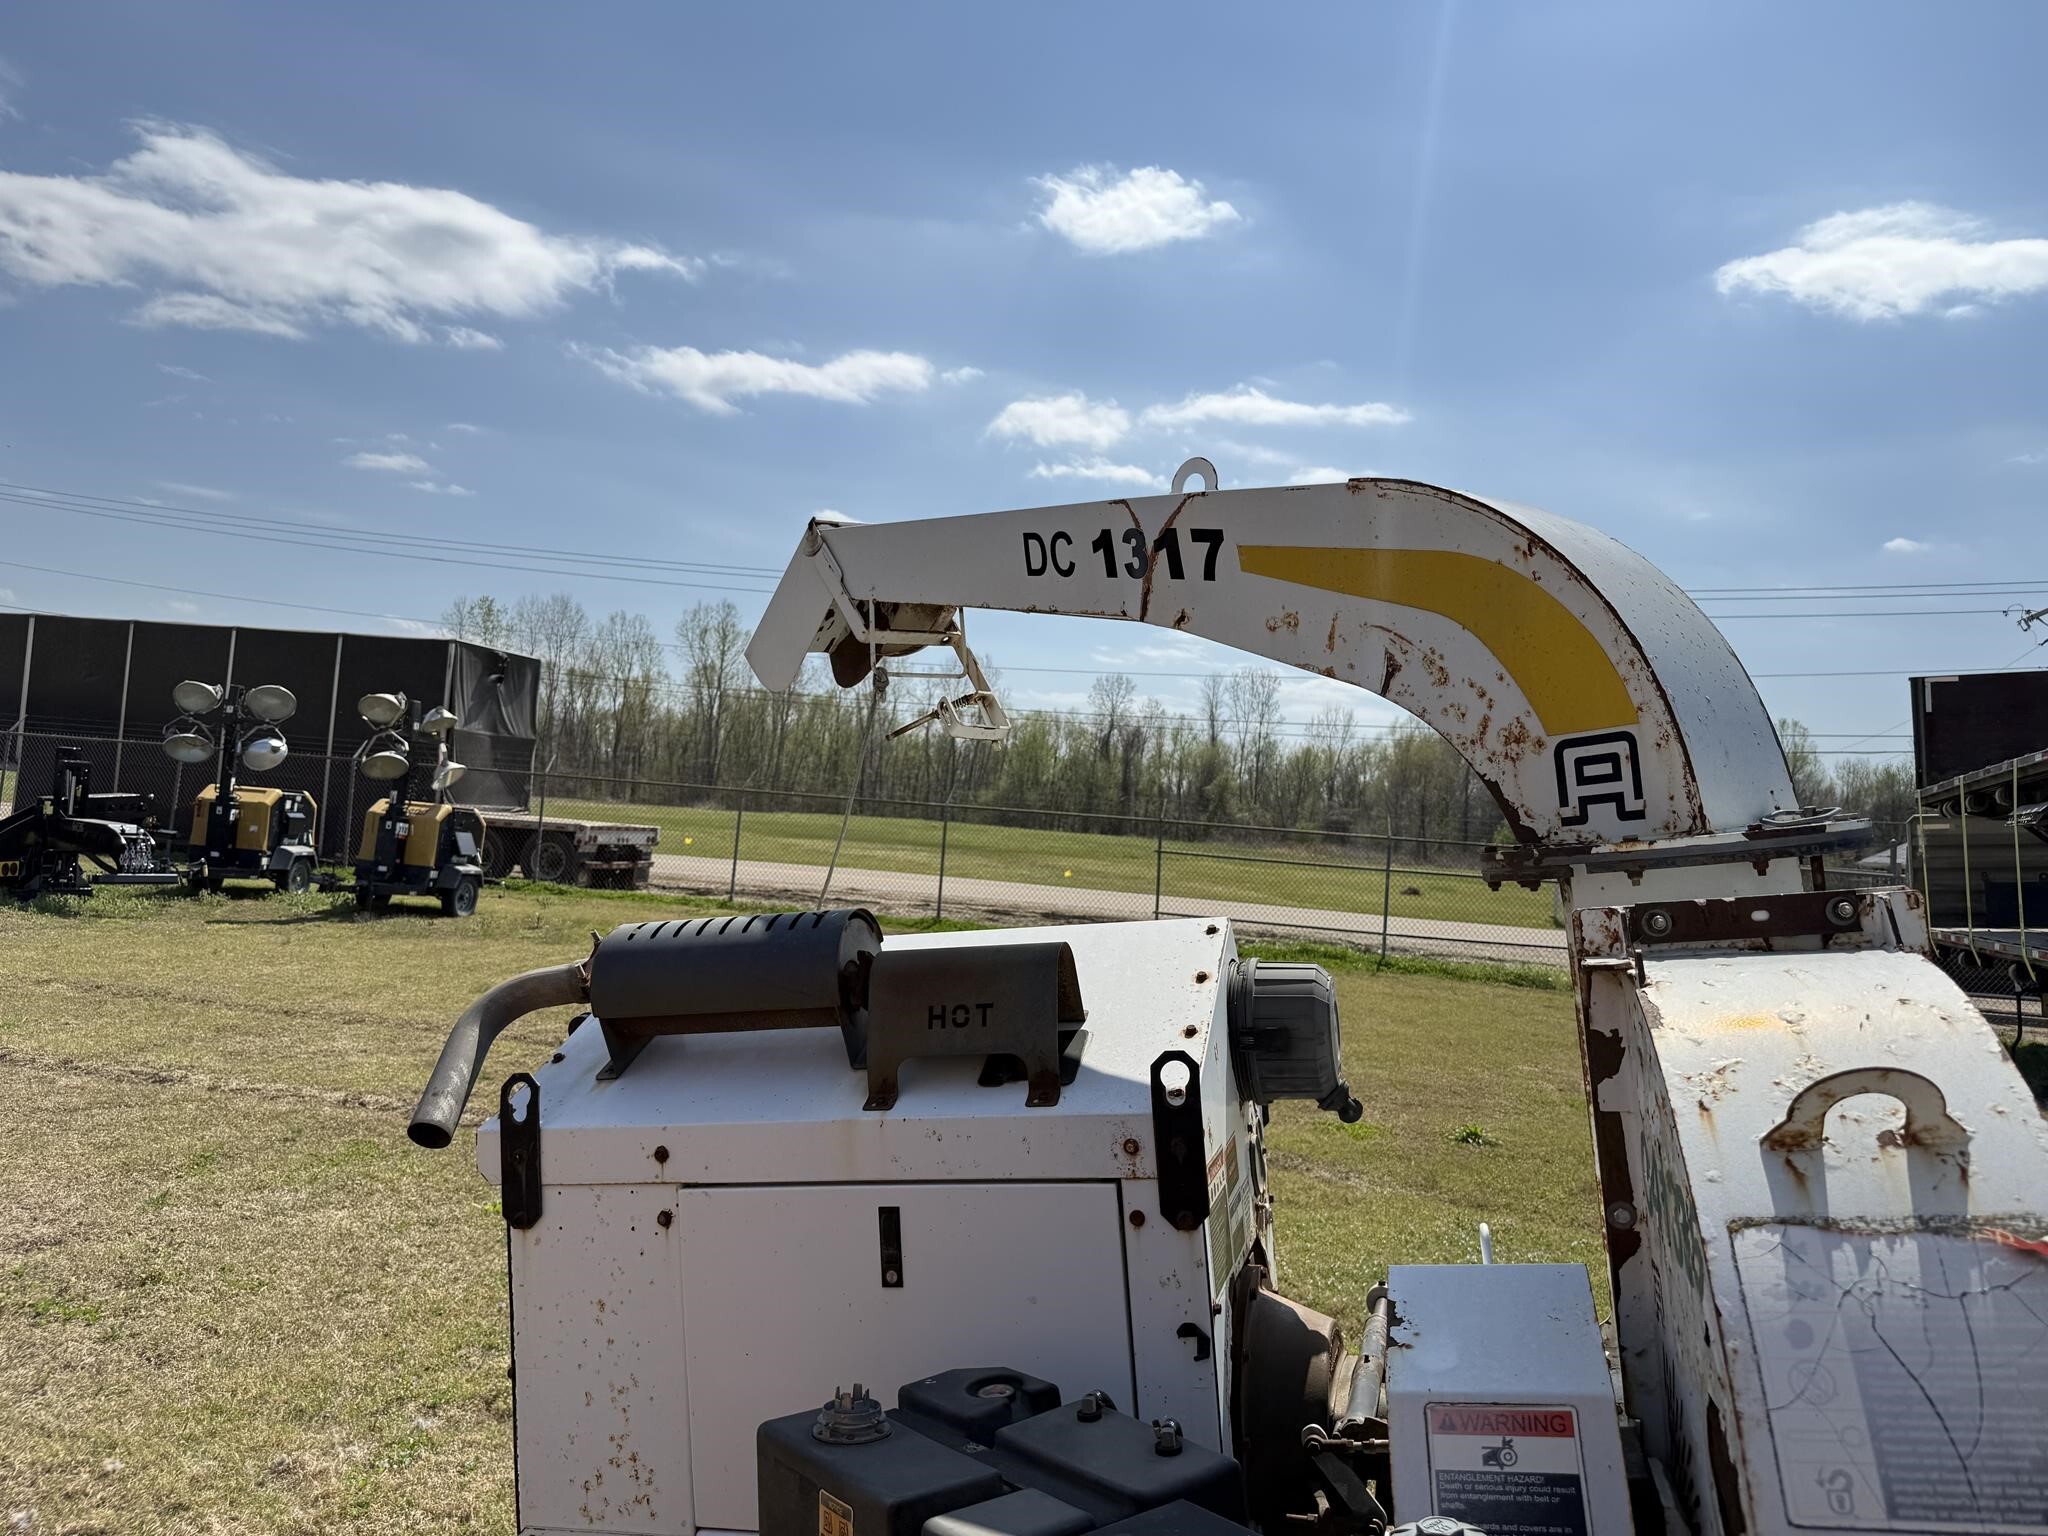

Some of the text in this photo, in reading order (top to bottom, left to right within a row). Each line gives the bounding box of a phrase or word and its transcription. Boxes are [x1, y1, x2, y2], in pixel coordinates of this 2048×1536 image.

[1022, 527, 1225, 582] DC 1317
[928, 1002, 994, 1030] HOT
[1459, 1413, 1567, 1433] WARNING
[1439, 1472, 1505, 1482] ENTANGLEMENT
[1439, 1481, 1462, 1490] Death
[1505, 1485, 1527, 1493] injury
[1529, 1485, 1551, 1493] could
[1553, 1486, 1576, 1494] result
[1460, 1492, 1514, 1502] entanglement
[1515, 1494, 1532, 1502] with
